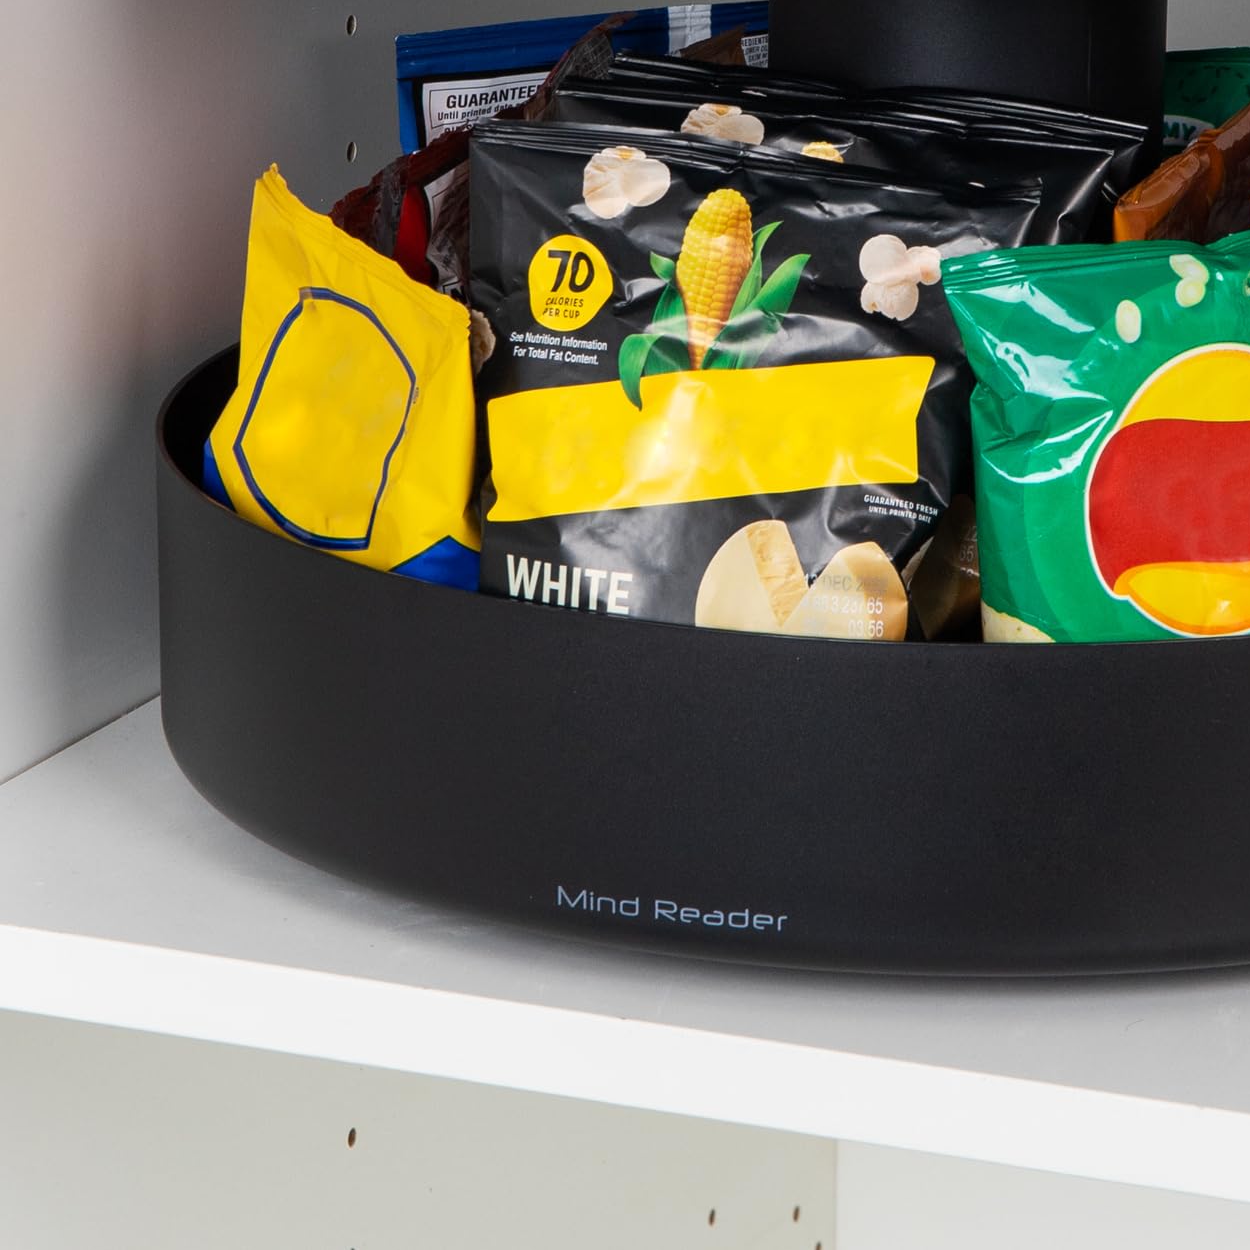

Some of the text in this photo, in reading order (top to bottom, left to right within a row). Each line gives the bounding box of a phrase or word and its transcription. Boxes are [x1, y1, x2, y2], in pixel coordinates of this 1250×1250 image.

[438, 107, 492, 121] Until printed
[548, 250, 595, 293] 70
[545, 297, 584, 308] CALORIES
[542, 307, 581, 319] PER CUP
[509, 331, 608, 351] See Nutrition Information
[513, 345, 599, 365] For Total Fat Content.
[864, 494, 938, 517] GUARANTEED FRESH
[868, 505, 932, 524] UNTIL PRINTED DATE
[505, 553, 634, 616] WHITE
[557, 885, 788, 932] Mind Reader
